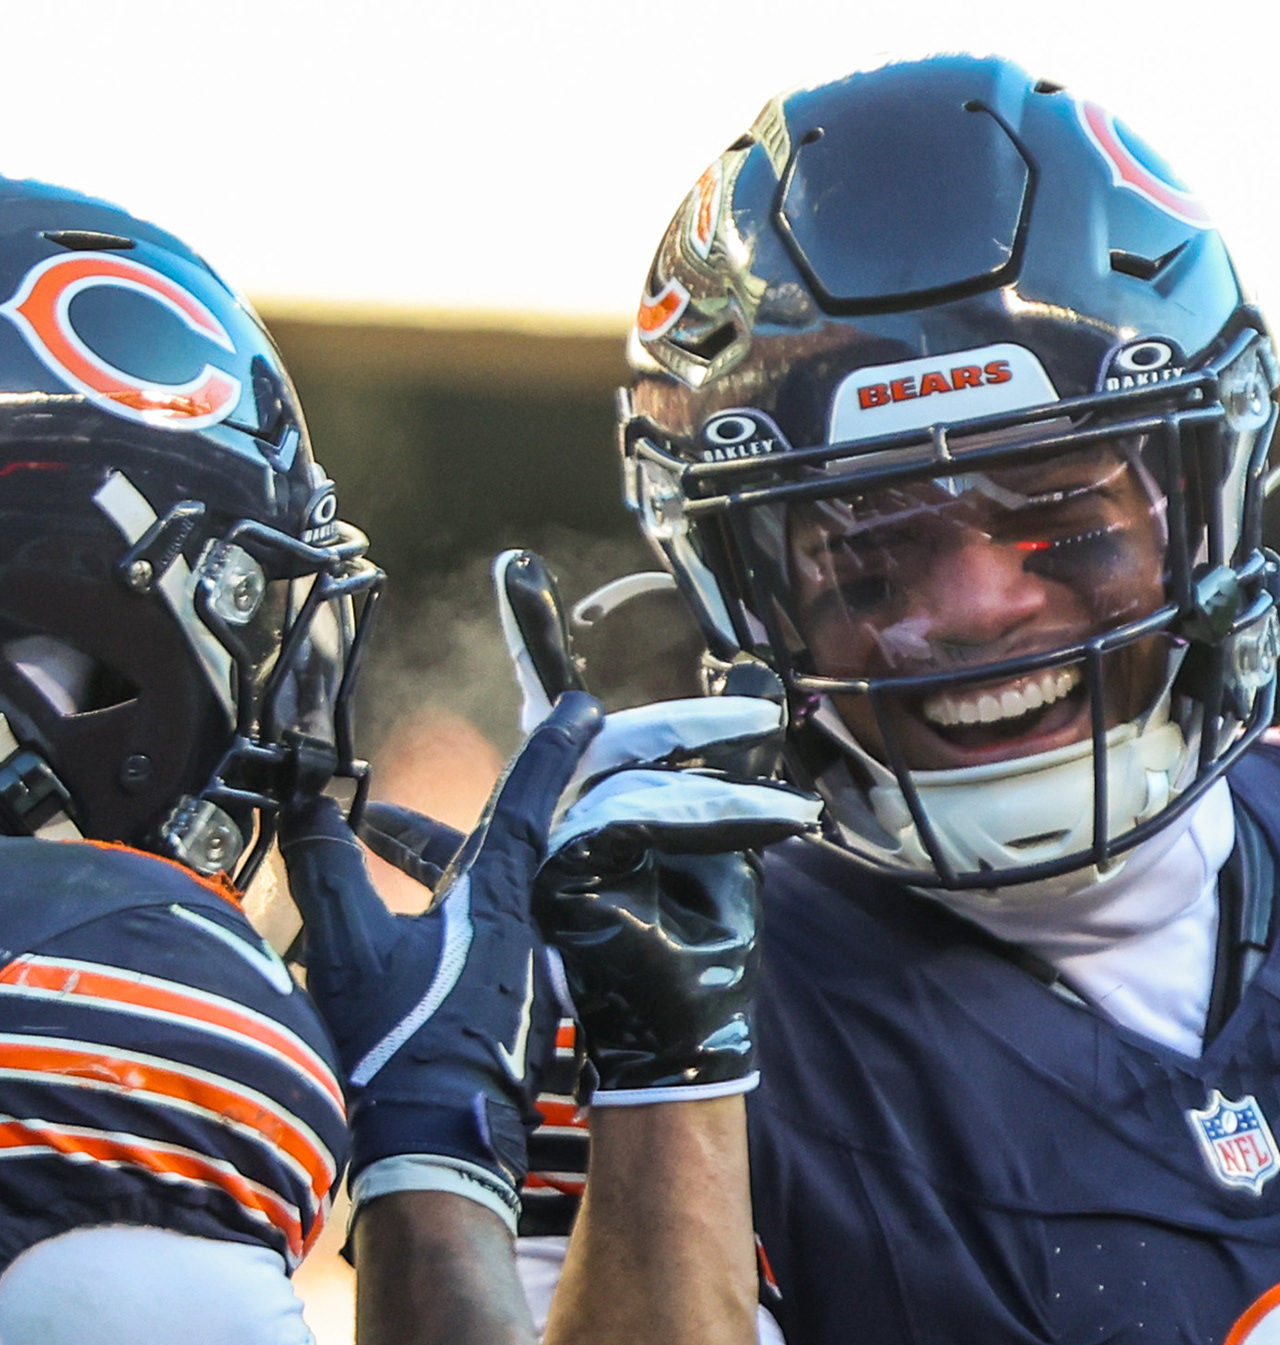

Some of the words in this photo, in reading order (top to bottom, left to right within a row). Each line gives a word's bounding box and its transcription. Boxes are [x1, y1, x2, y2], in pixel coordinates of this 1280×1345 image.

[857, 360, 1013, 410] BEARS
[703, 439, 773, 462] OAKLEY
[1217, 1133, 1269, 1173] NFL
